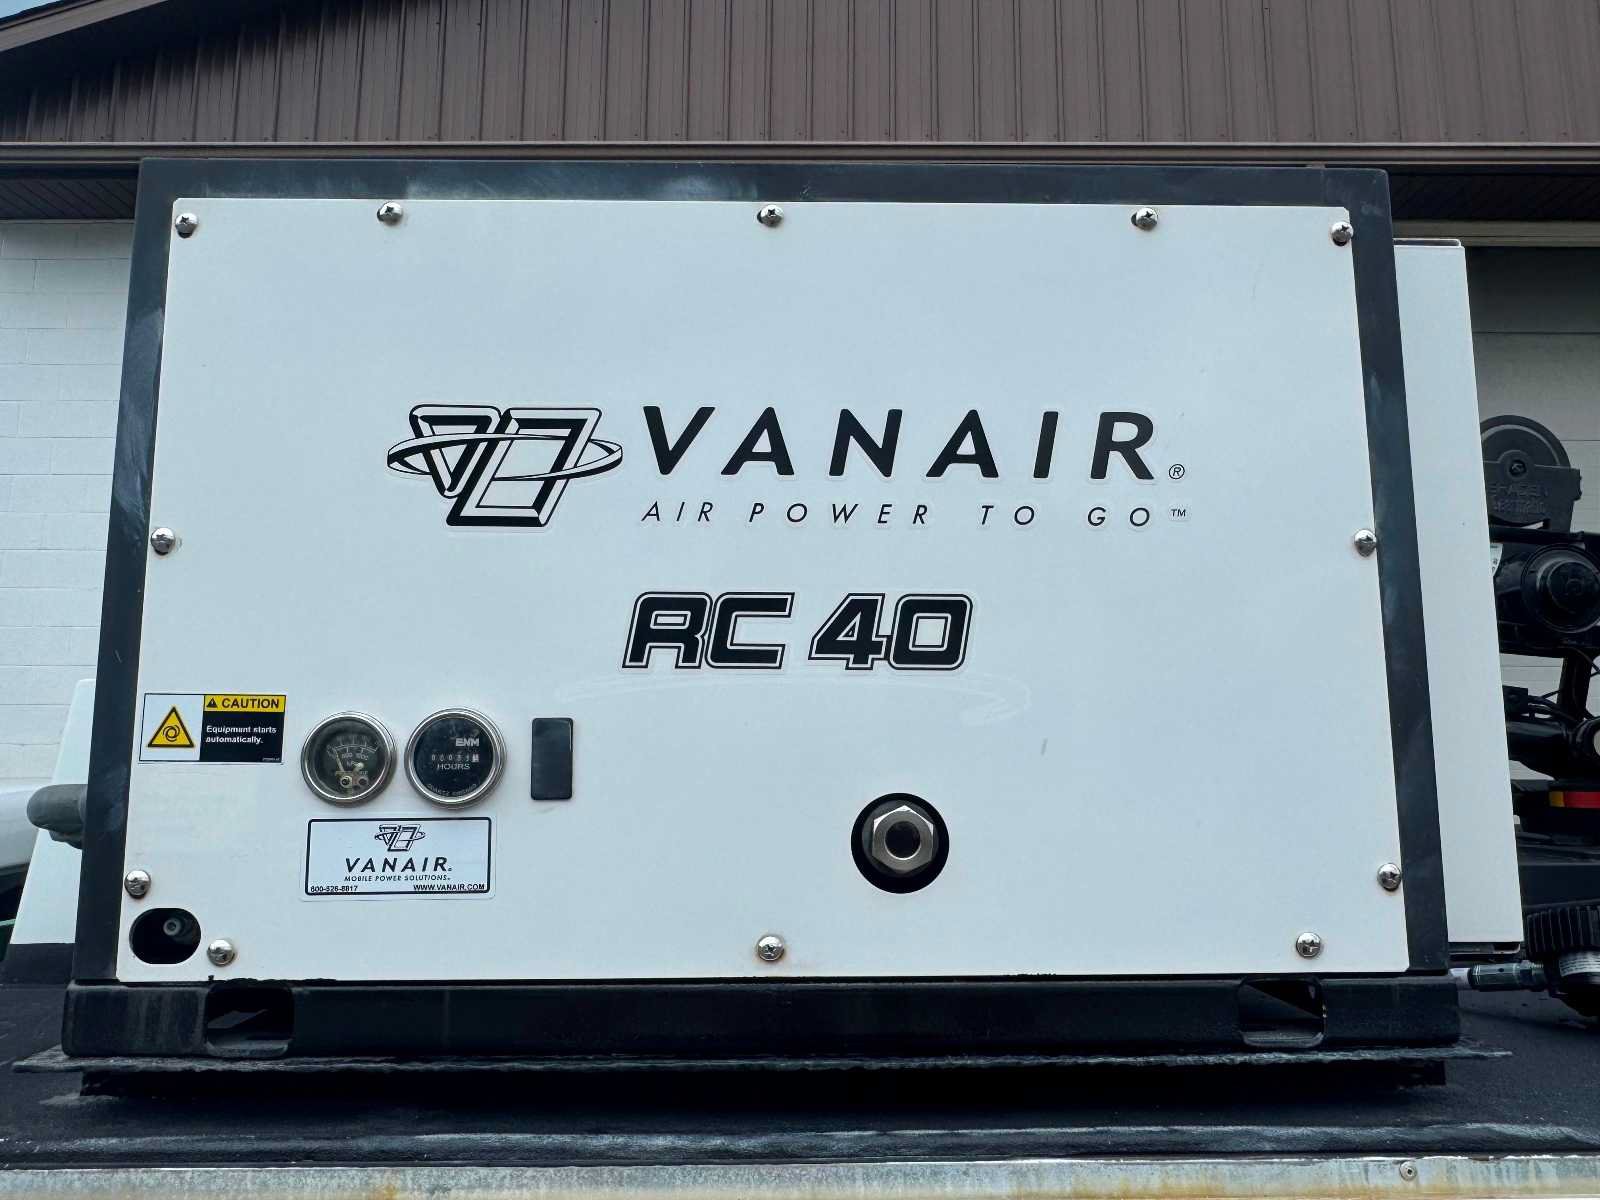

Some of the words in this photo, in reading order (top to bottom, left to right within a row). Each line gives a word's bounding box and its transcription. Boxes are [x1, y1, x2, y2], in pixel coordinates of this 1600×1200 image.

[640, 500, 714, 522] AIR
[748, 502, 928, 525] POWER
[981, 504, 1035, 526] TO
[621, 591, 796, 670] RC
[807, 592, 974, 672] 40
[221, 698, 280, 709] CAUTION
[206, 725, 251, 735] Equipment
[253, 726, 277, 734] starts
[205, 736, 264, 745] automatically.
[436, 762, 471, 771] HOURS
[413, 883, 485, 891] WWW.VANAIR.COM
